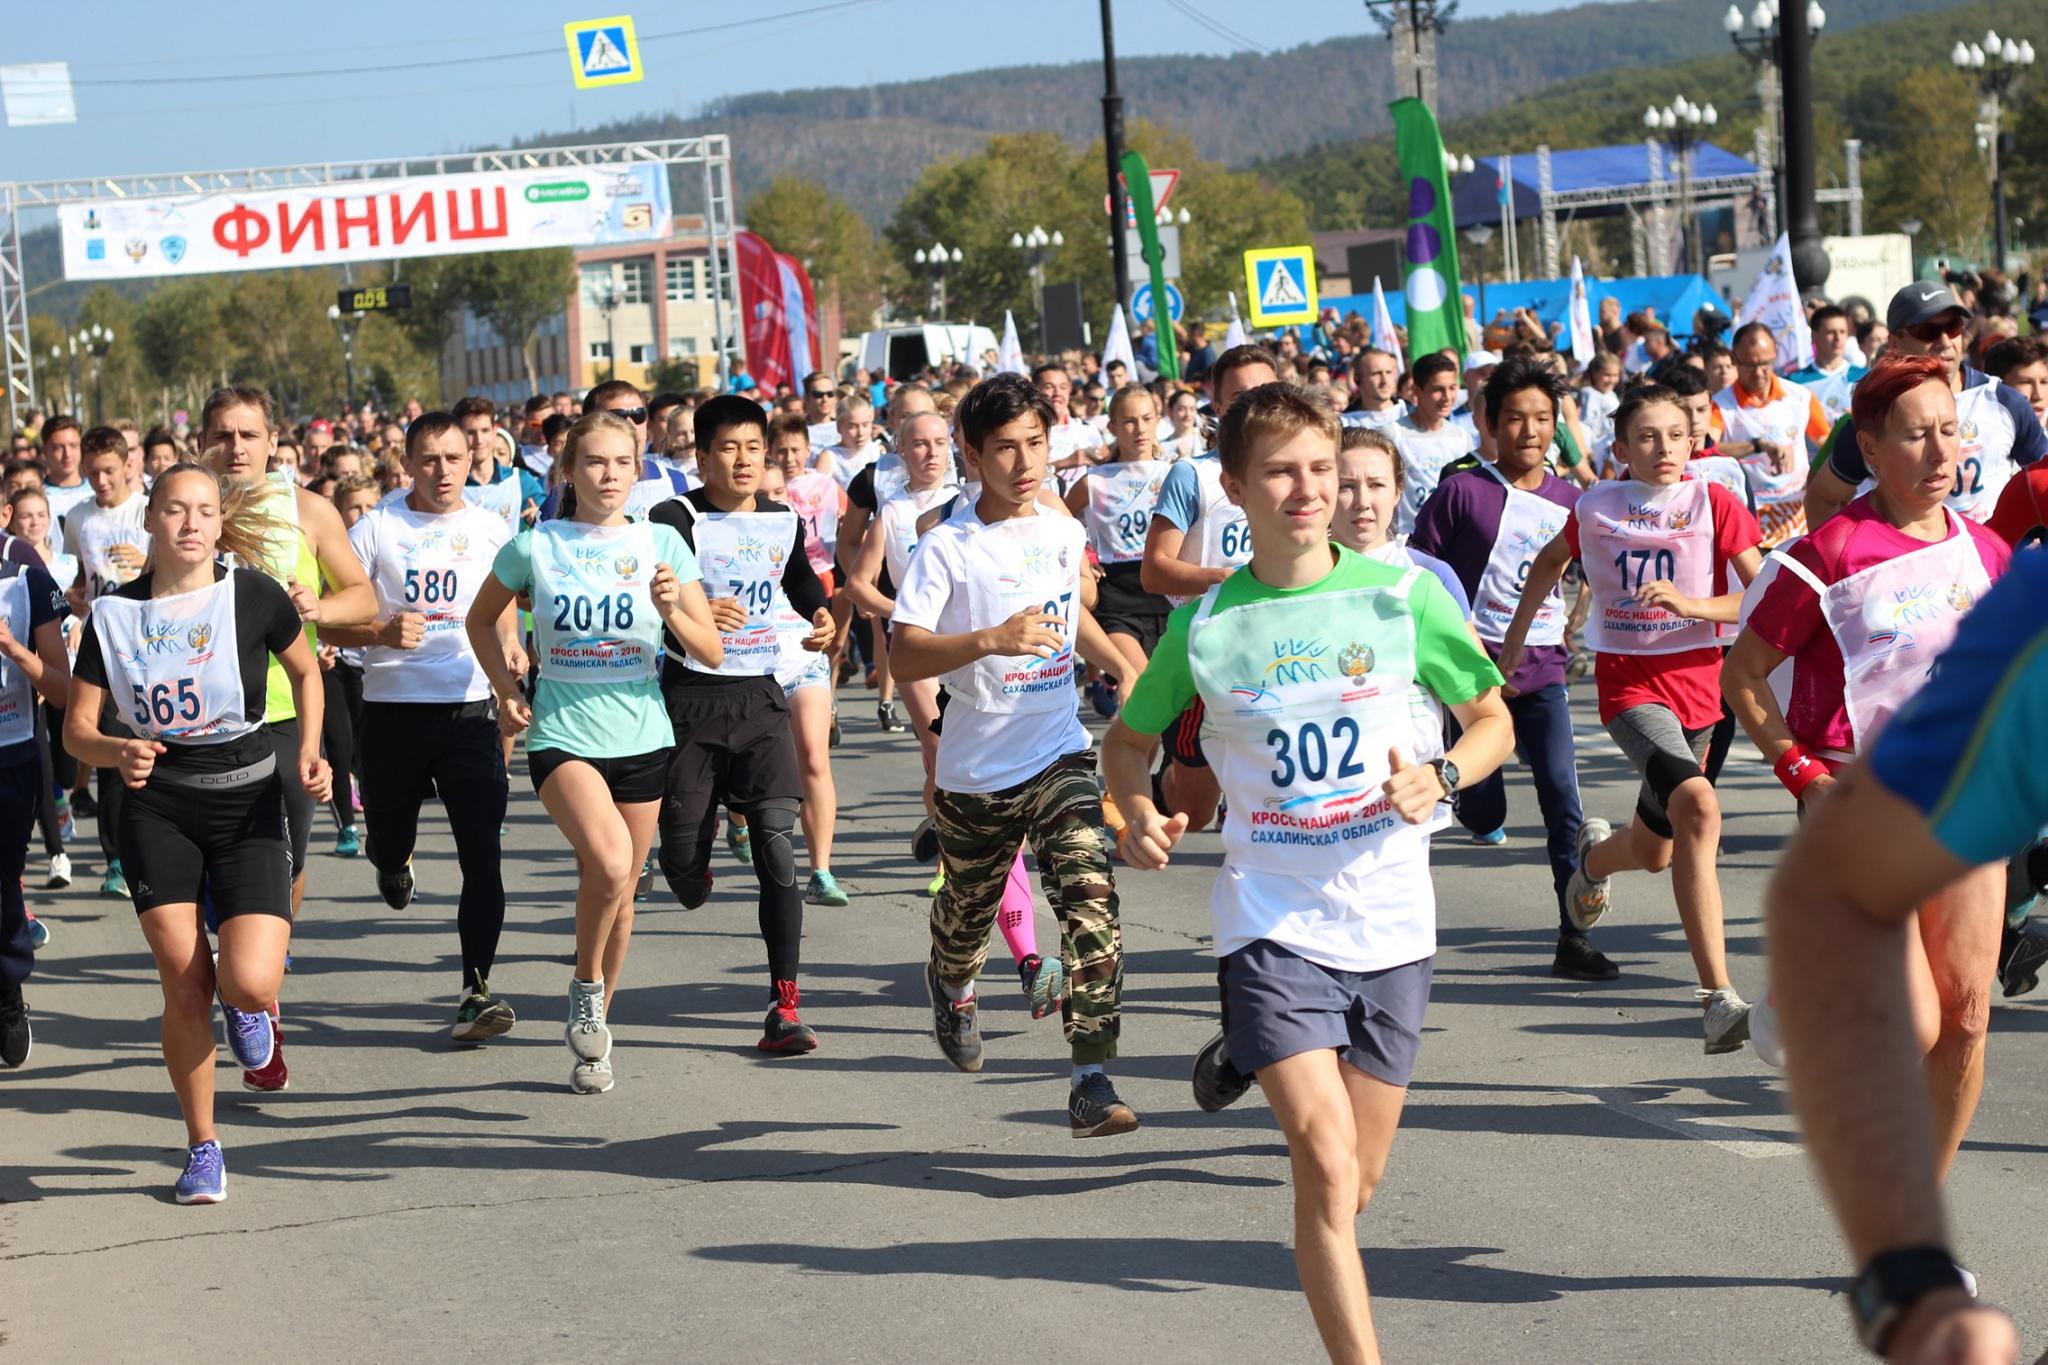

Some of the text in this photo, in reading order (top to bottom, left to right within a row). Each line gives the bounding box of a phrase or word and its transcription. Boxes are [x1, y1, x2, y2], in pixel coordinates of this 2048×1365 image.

[212, 185, 509, 258] ФИНИШ
[1415, 486, 1437, 508] 2
[1119, 508, 1155, 540] 29
[1614, 548, 1675, 591] 170
[404, 569, 457, 603] 580
[553, 592, 634, 633] 2018
[1604, 619, 1697, 632] САХАЛИНСКАЯ ОБЛАСТЬ
[1605, 608, 1630, 620] КРОСС
[1632, 611, 1667, 622] НАЦИИ
[550, 647, 579, 657] КРОСС
[582, 648, 614, 659] НАЦИИ
[550, 656, 642, 668] САХАЛИНСКАЯ ОБЛАСТЬ
[1002, 679, 1063, 695] САХАЛИНСКАЯ
[1004, 670, 1038, 683] КРОСС
[133, 677, 201, 726] 565
[1267, 716, 1365, 788] 302
[1251, 811, 1297, 827] КРОСС
[1299, 809, 1350, 830] НАЦИИ
[1251, 815, 1394, 847] САХАЛИНСКАЯ ОБЛАСТЬ
